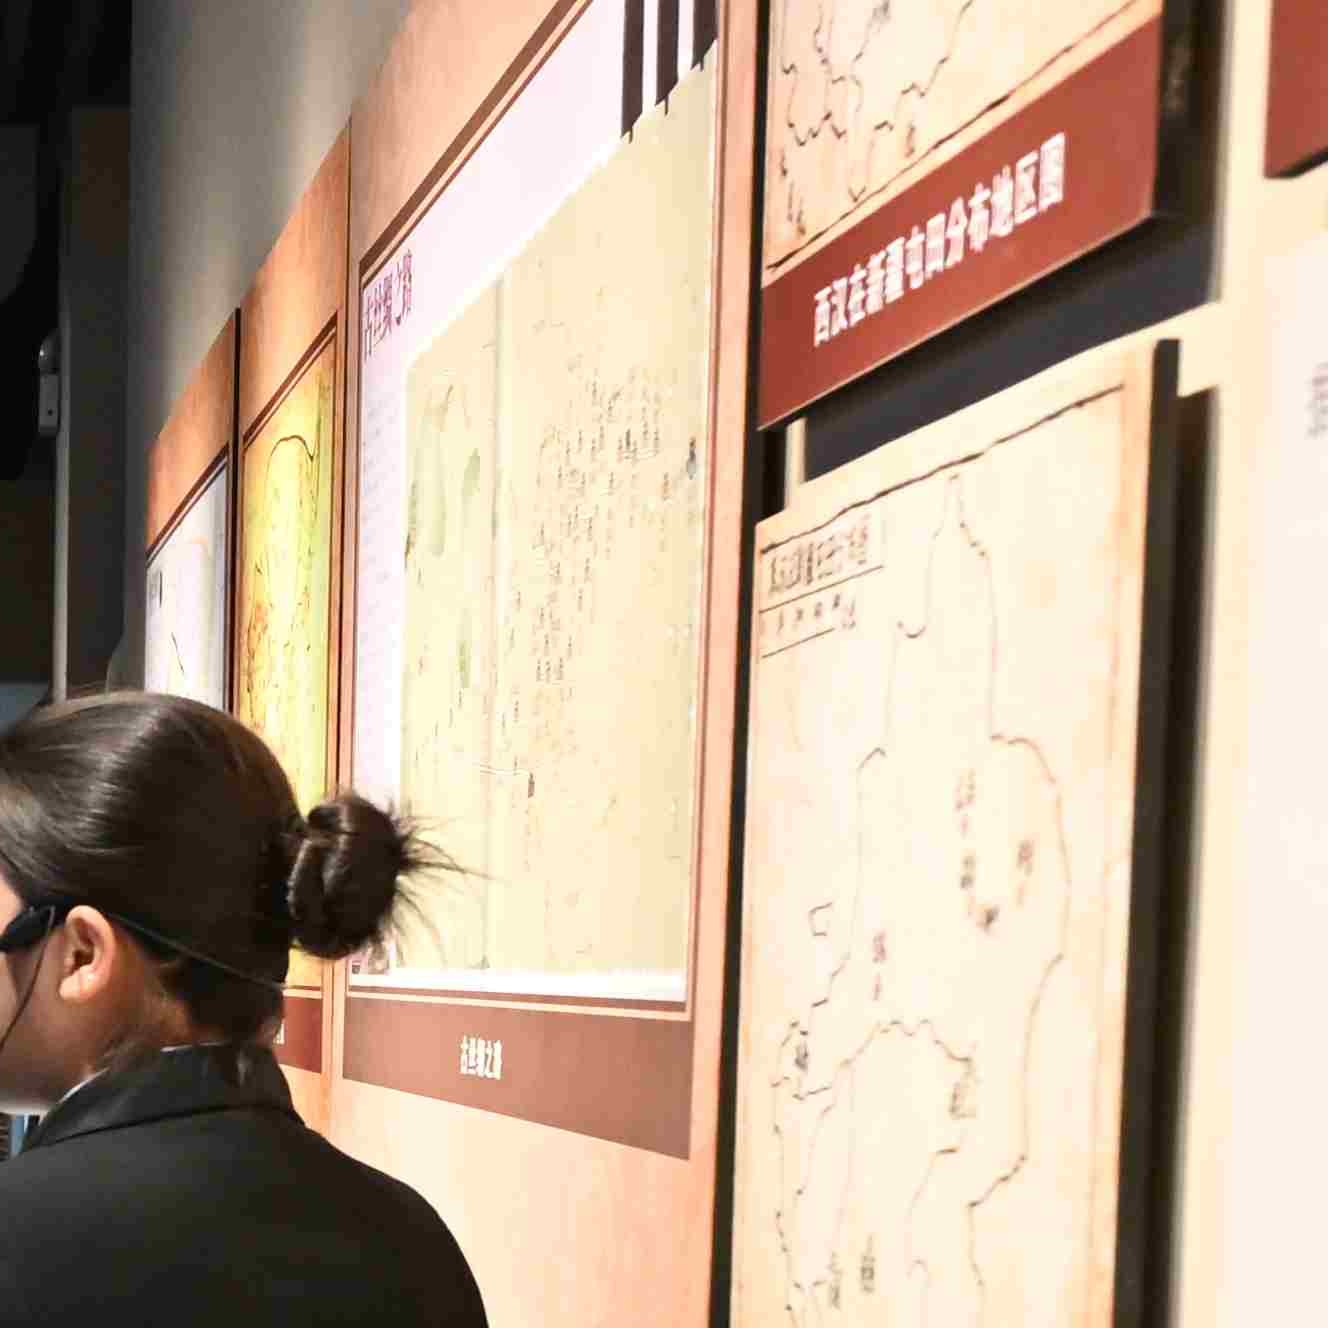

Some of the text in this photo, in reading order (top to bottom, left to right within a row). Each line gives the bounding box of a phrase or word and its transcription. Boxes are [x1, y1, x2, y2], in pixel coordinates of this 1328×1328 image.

[813, 131, 1066, 347] 西汉在新疆屯田分布地区图
